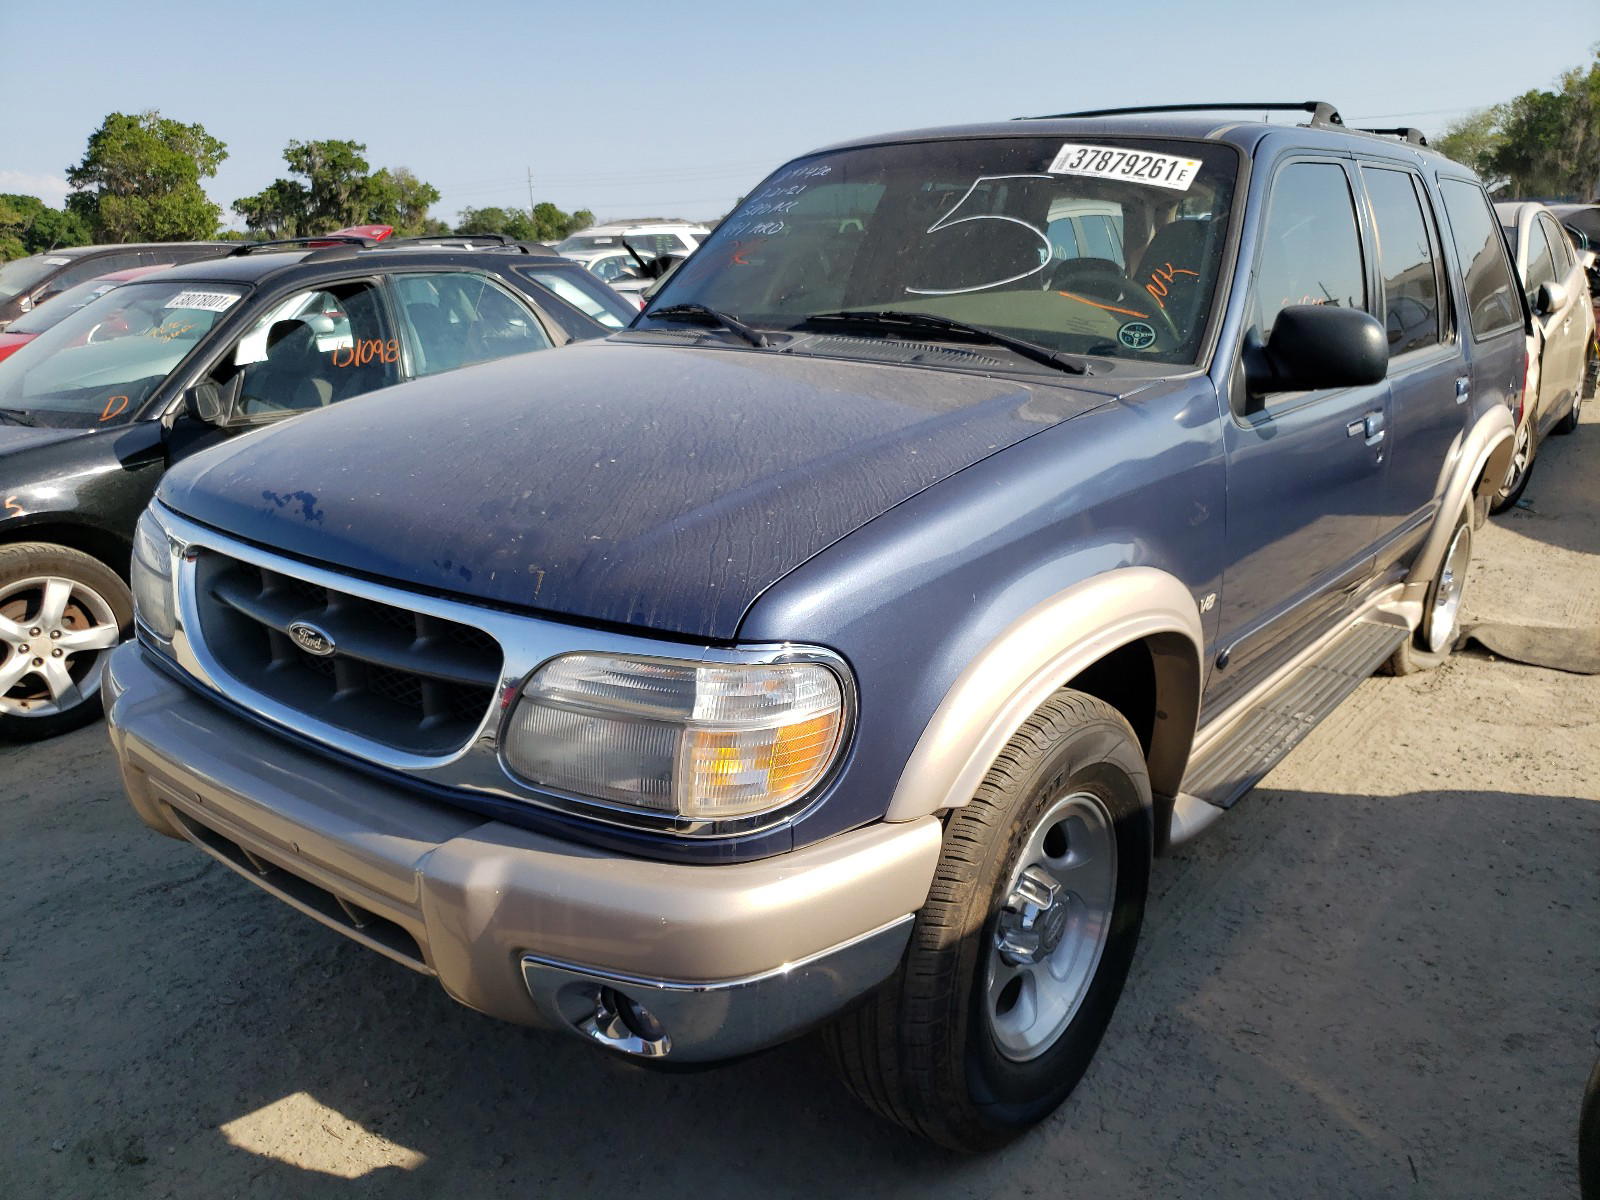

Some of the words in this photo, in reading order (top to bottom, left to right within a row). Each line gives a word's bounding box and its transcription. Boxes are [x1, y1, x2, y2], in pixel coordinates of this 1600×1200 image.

[1069, 148, 1178, 181] 37879261
[1177, 169, 1188, 182] E
[905, 174, 1055, 294] 5
[98, 395, 129, 422] D
[298, 627, 323, 650] Ford
